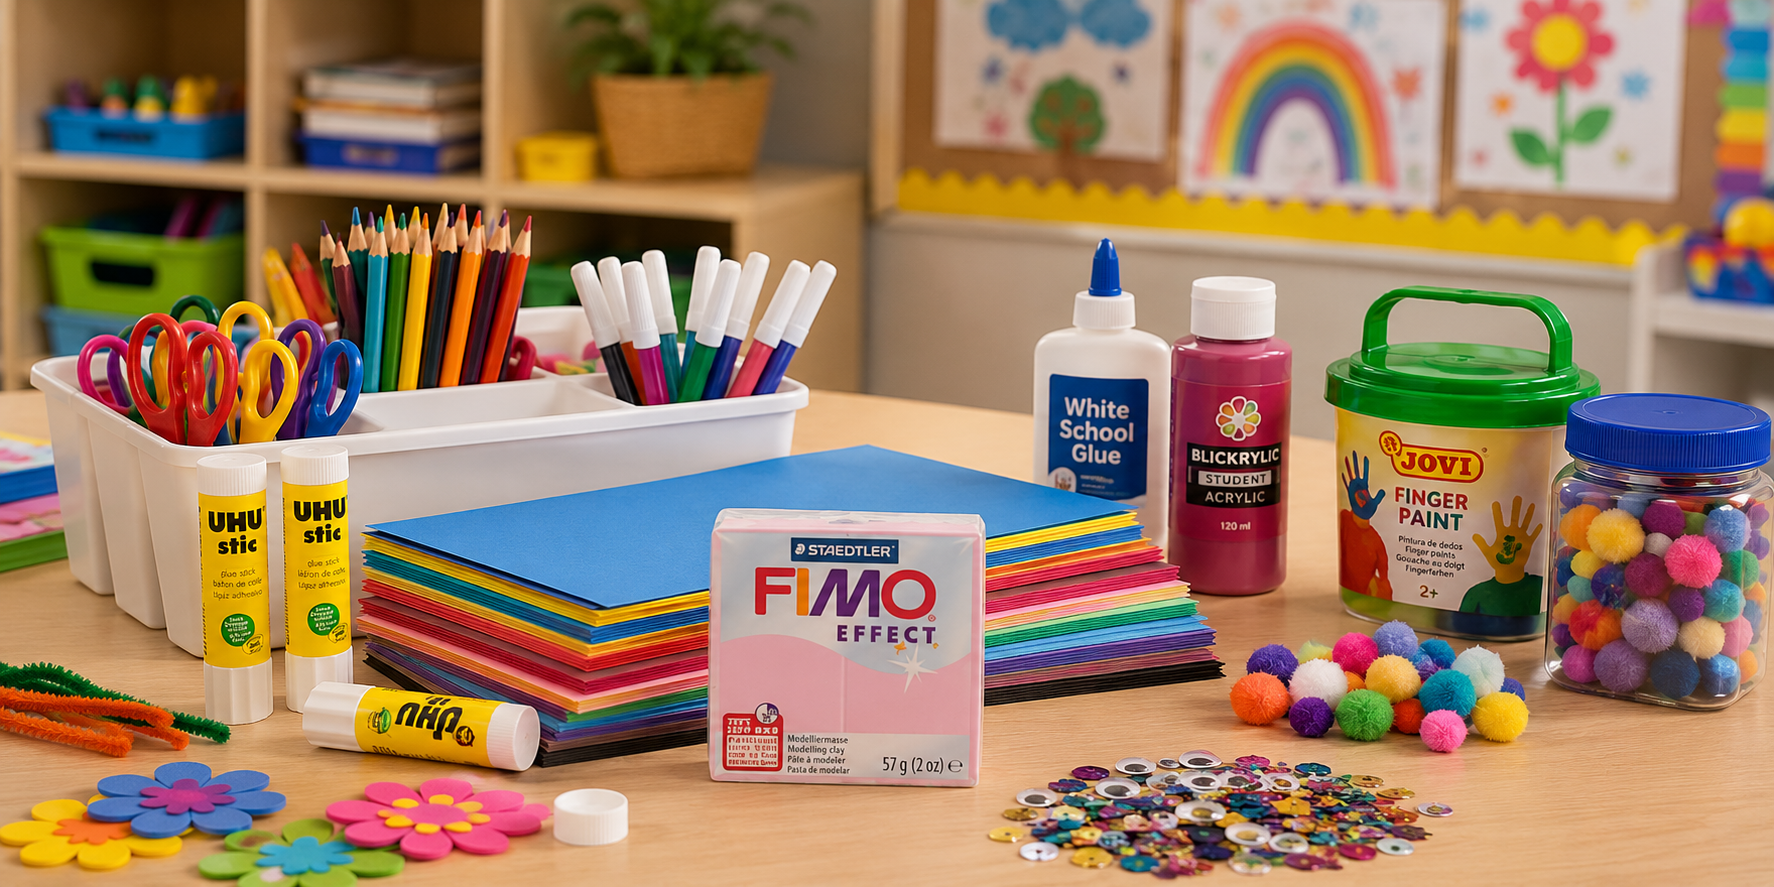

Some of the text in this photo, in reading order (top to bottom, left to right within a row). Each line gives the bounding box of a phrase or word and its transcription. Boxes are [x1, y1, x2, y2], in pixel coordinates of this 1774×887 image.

[1064, 396, 1130, 419] White
[1059, 419, 1134, 442] School
[1071, 444, 1121, 465] Glue
[1191, 447, 1279, 466] BLICKRYLIC
[1401, 451, 1472, 476] JOVI
[1205, 473, 1268, 485] STUDENT
[1205, 491, 1265, 504] ACRYLIC
[1395, 486, 1468, 511] FINGER
[293, 496, 346, 522] UHU
[1399, 507, 1463, 531] PAINT
[208, 507, 262, 533] UHU
[1220, 521, 1251, 531] 120 ml
[303, 523, 341, 544] stic
[1427, 539, 1437, 548] de
[218, 535, 257, 555] stic
[808, 543, 891, 558] STAEDTLER
[754, 567, 937, 620] FIMO
[1420, 585, 1438, 598] 2+
[837, 624, 936, 644] EFFECT
[787, 734, 849, 744] Modelliermasse
[787, 745, 827, 755] Modelling
[808, 765, 818, 774] de
[819, 766, 850, 774] modelar
[882, 756, 898, 772] 57
[899, 760, 907, 776] g
[911, 757, 924, 774] (2
[926, 757, 945, 774] oz)
